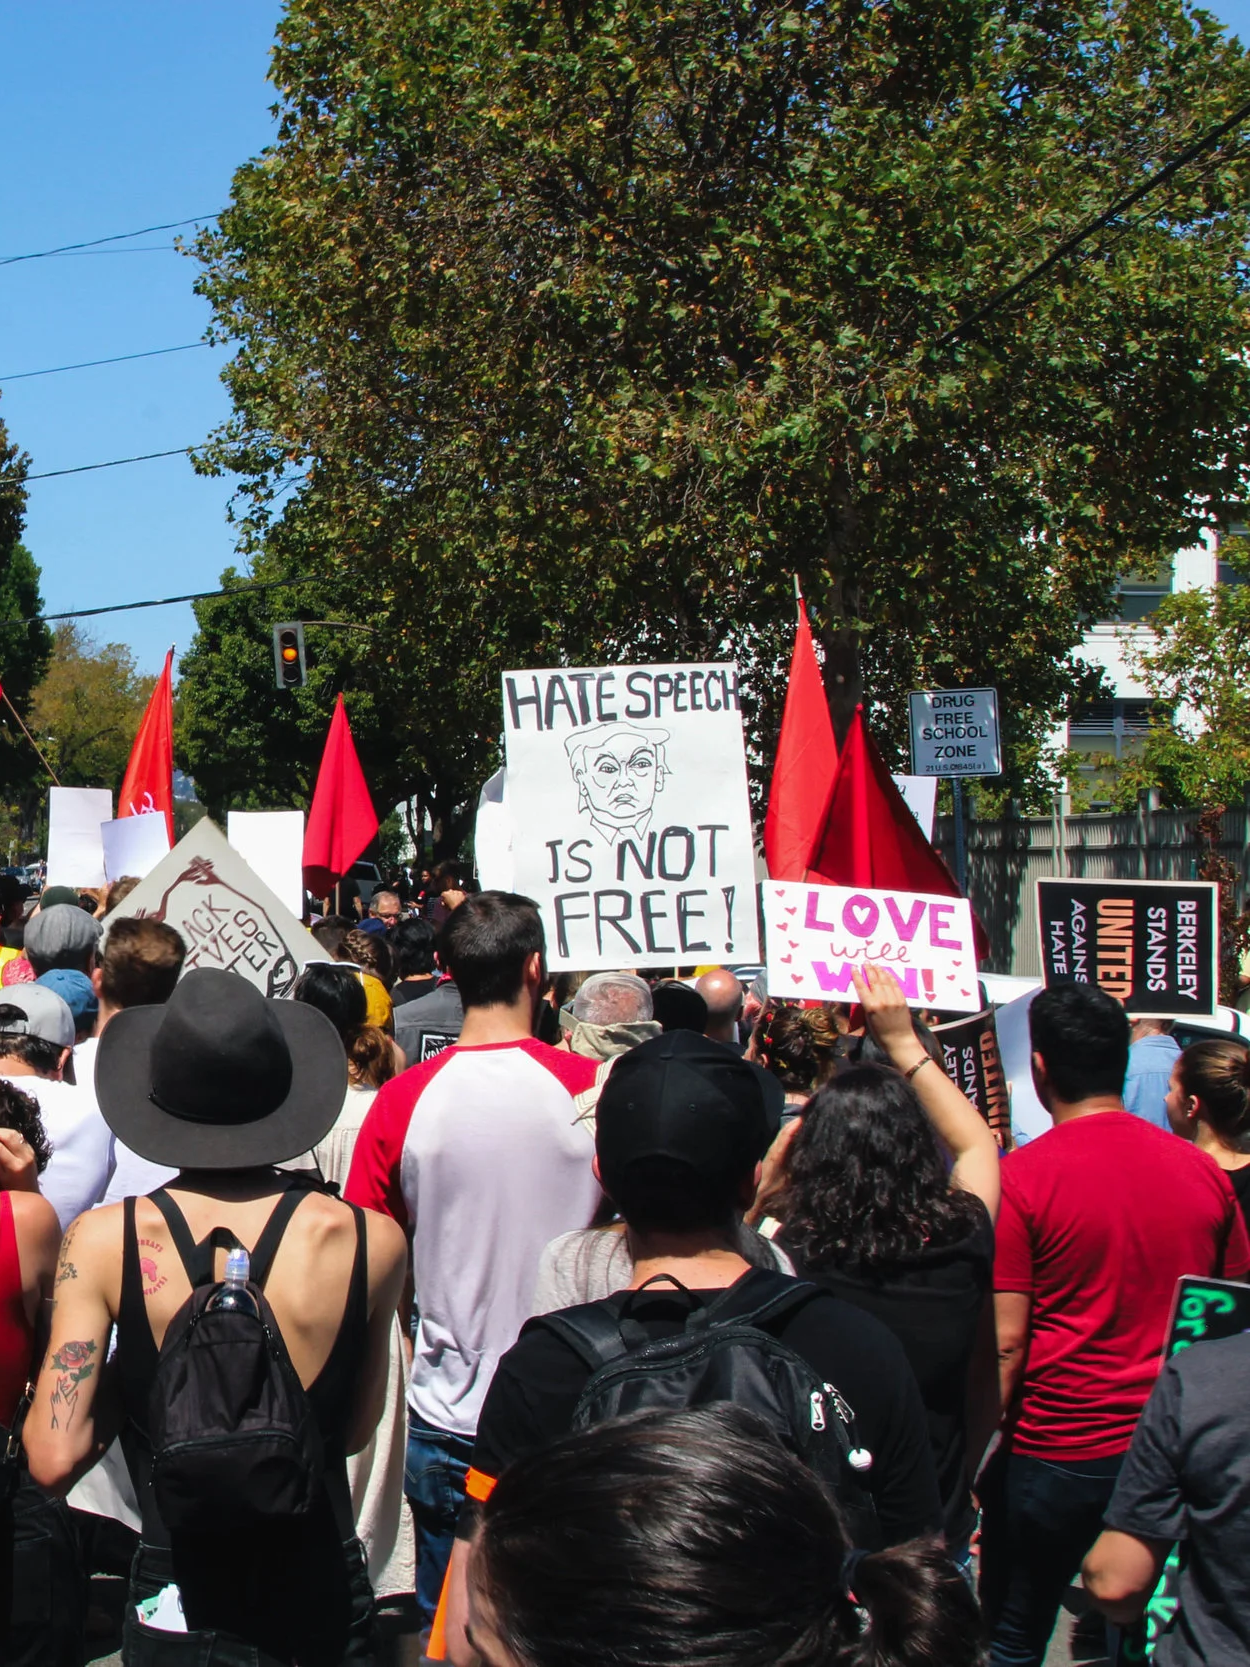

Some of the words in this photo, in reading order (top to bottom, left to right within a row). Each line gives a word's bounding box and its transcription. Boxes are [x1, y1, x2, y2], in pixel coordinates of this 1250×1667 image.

[505, 671, 618, 731] HATE
[625, 670, 741, 718] SPEECH
[932, 695, 975, 708] DRUG
[935, 712, 974, 725] FREE
[923, 726, 988, 740] SCHOOL
[935, 745, 977, 758] ZONE
[546, 839, 593, 883] IS
[617, 824, 729, 882] NOT
[182, 893, 231, 955] ACK
[554, 885, 735, 958] FREE!
[804, 891, 962, 951] LOVE
[1051, 921, 1067, 975] HATE
[1071, 899, 1088, 983] AGAINS
[1097, 899, 1134, 999] UNITED
[1146, 907, 1167, 992] STANDS
[1177, 901, 1198, 1000] BERKELEY
[225, 931, 279, 973] TER
[830, 940, 911, 963] will
[811, 961, 937, 1003] WN!
[962, 1046, 979, 1110] ANDS
